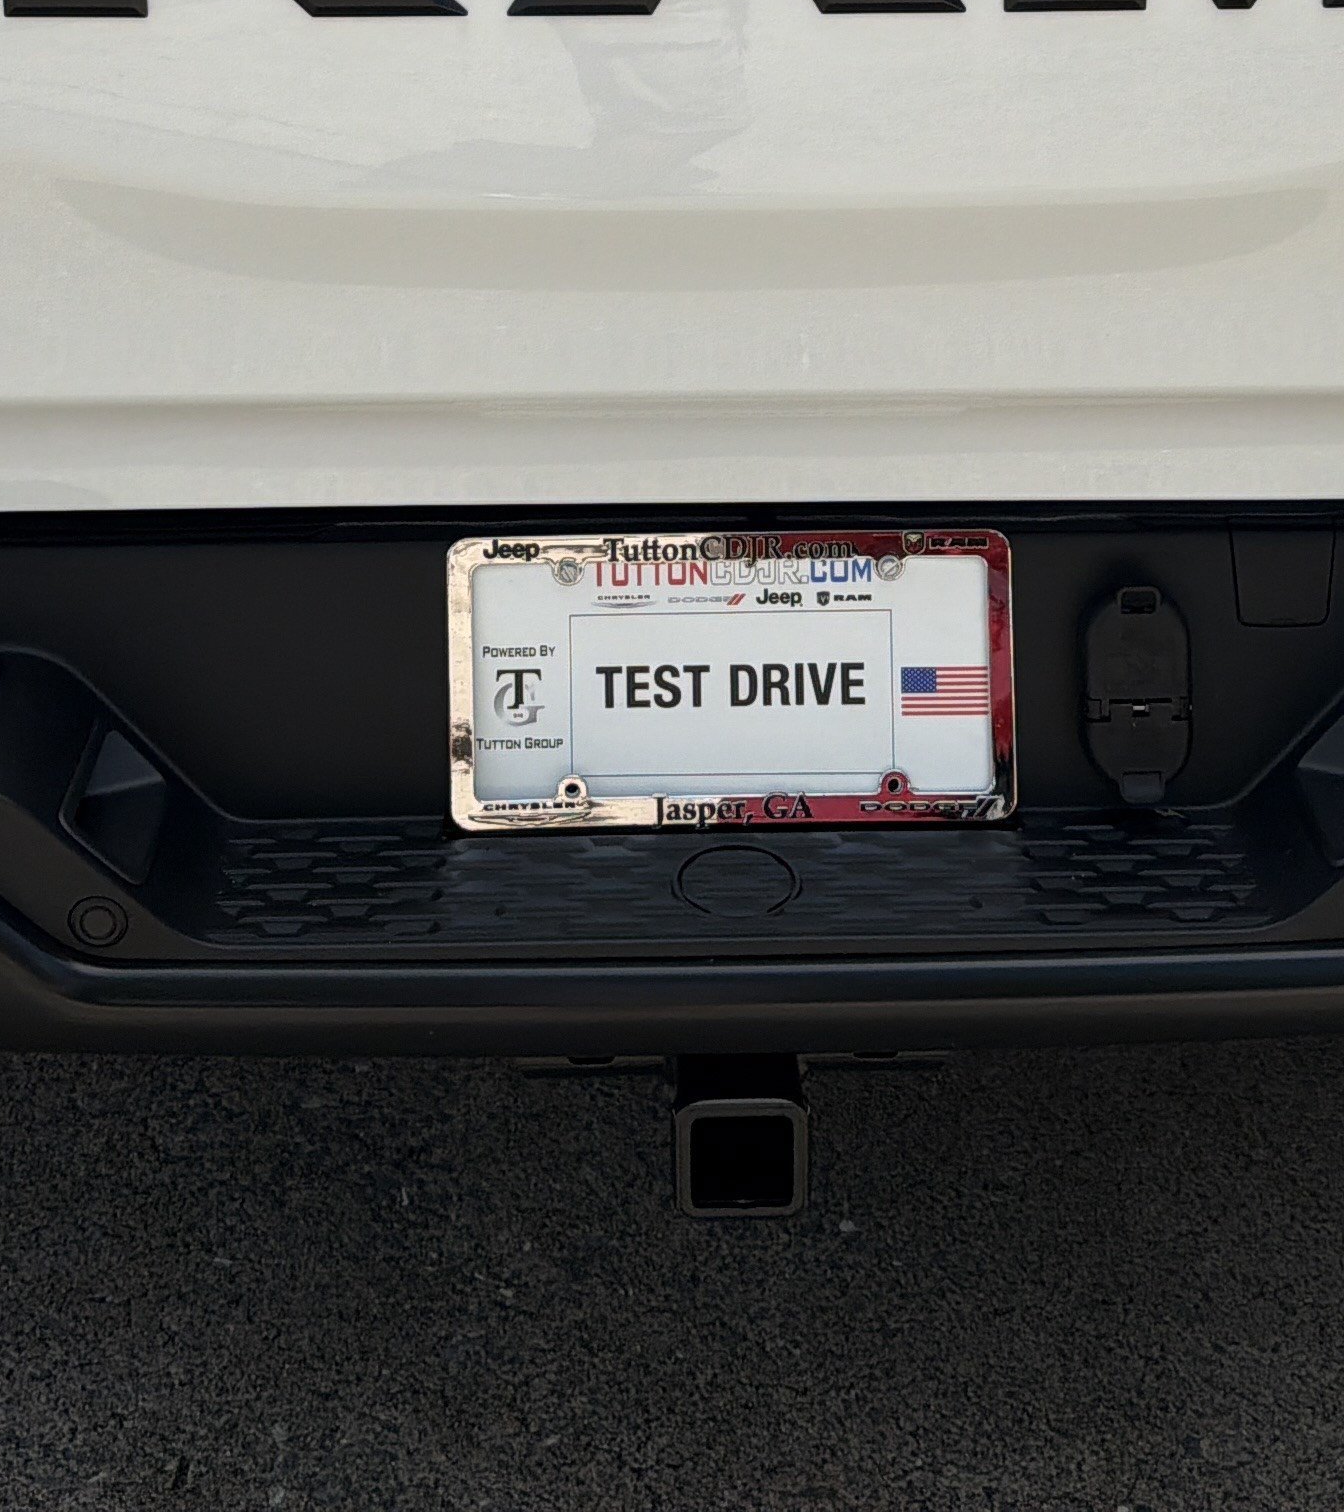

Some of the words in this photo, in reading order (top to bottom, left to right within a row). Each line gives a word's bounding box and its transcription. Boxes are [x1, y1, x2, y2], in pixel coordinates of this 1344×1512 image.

[483, 539, 541, 561] Jeep
[603, 536, 861, 568] TuttonCDJR.com
[756, 588, 803, 607] Jeep
[595, 664, 710, 708] TEST
[729, 662, 866, 707] DRIVE
[482, 802, 576, 812] CHRYSLER
[652, 792, 754, 829] Jasper,
[763, 791, 815, 819] GA
